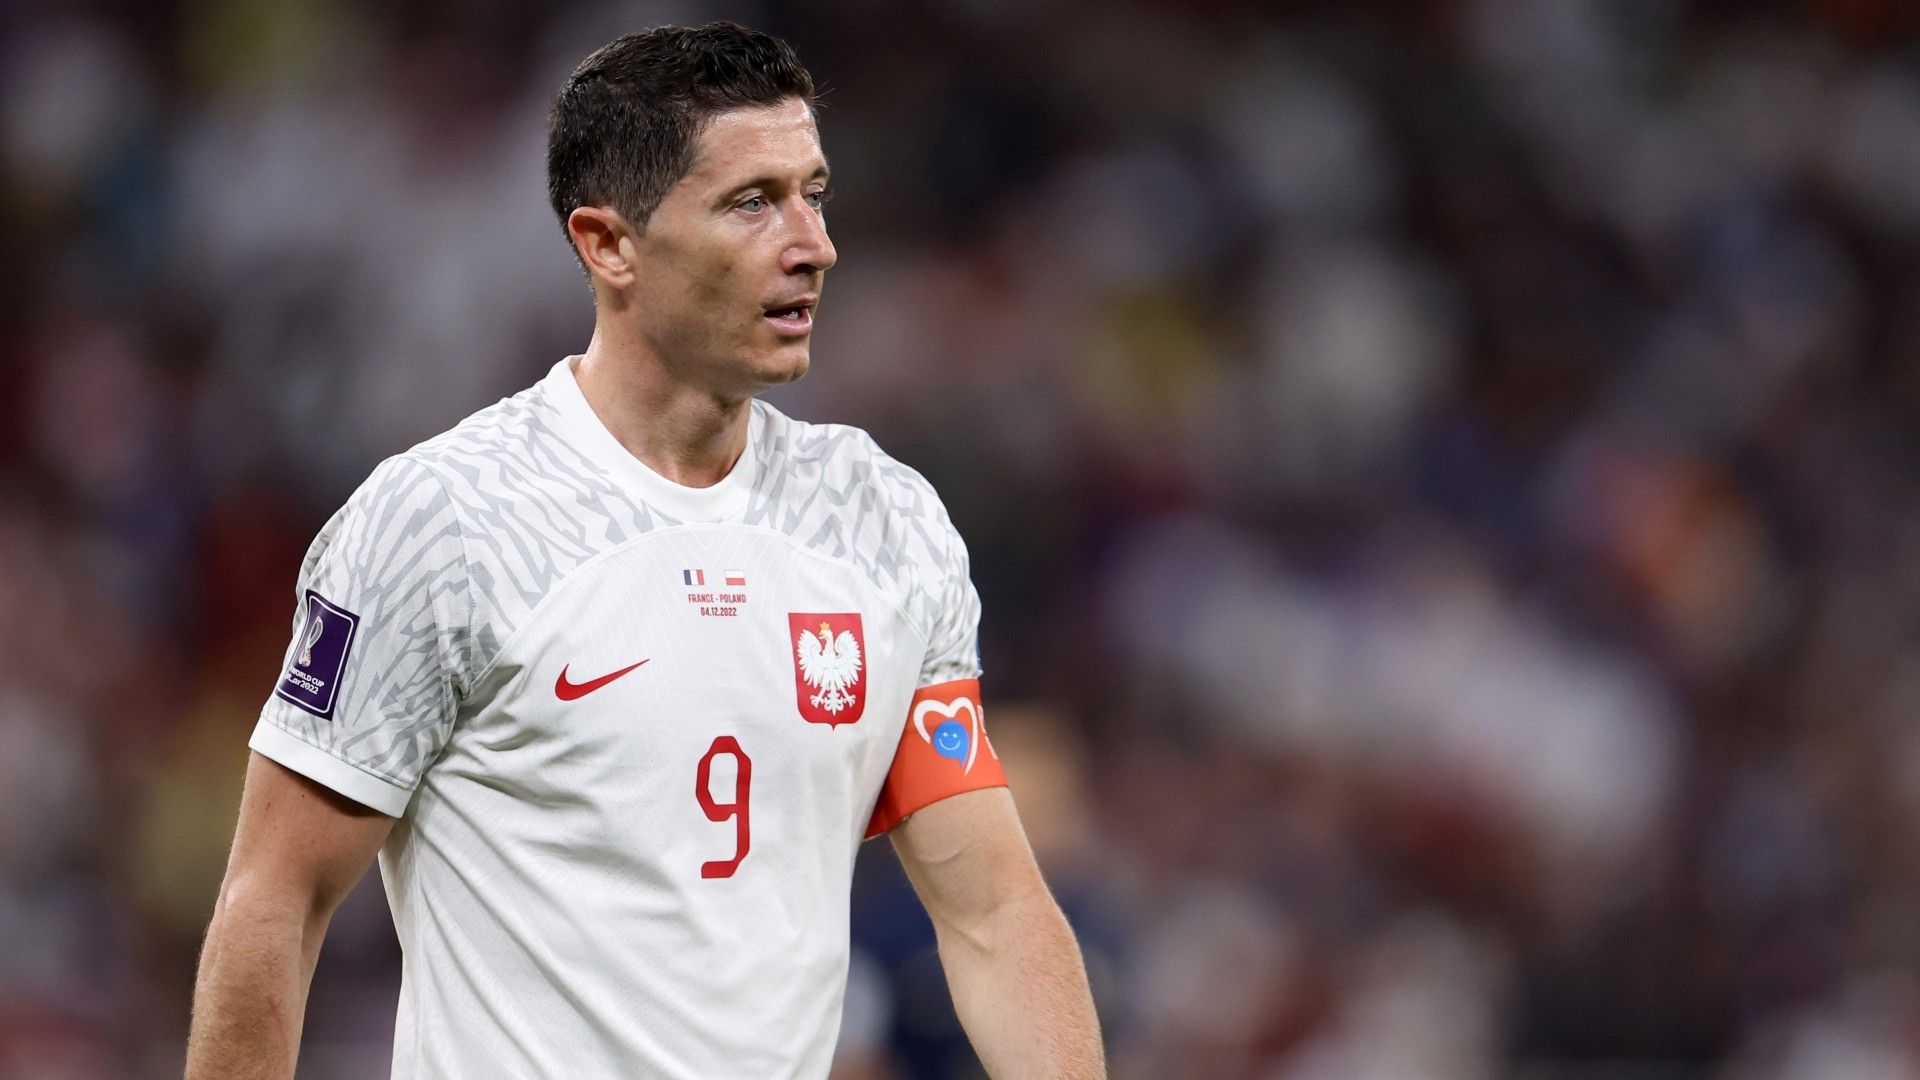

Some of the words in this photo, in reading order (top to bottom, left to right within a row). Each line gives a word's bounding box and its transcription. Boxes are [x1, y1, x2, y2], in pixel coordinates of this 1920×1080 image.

[688, 593, 714, 603] FRANCE
[719, 593, 747, 603] POLAND
[700, 606, 737, 616] 04.12.2022
[311, 677, 325, 688] CUP
[695, 735, 752, 879] 9
